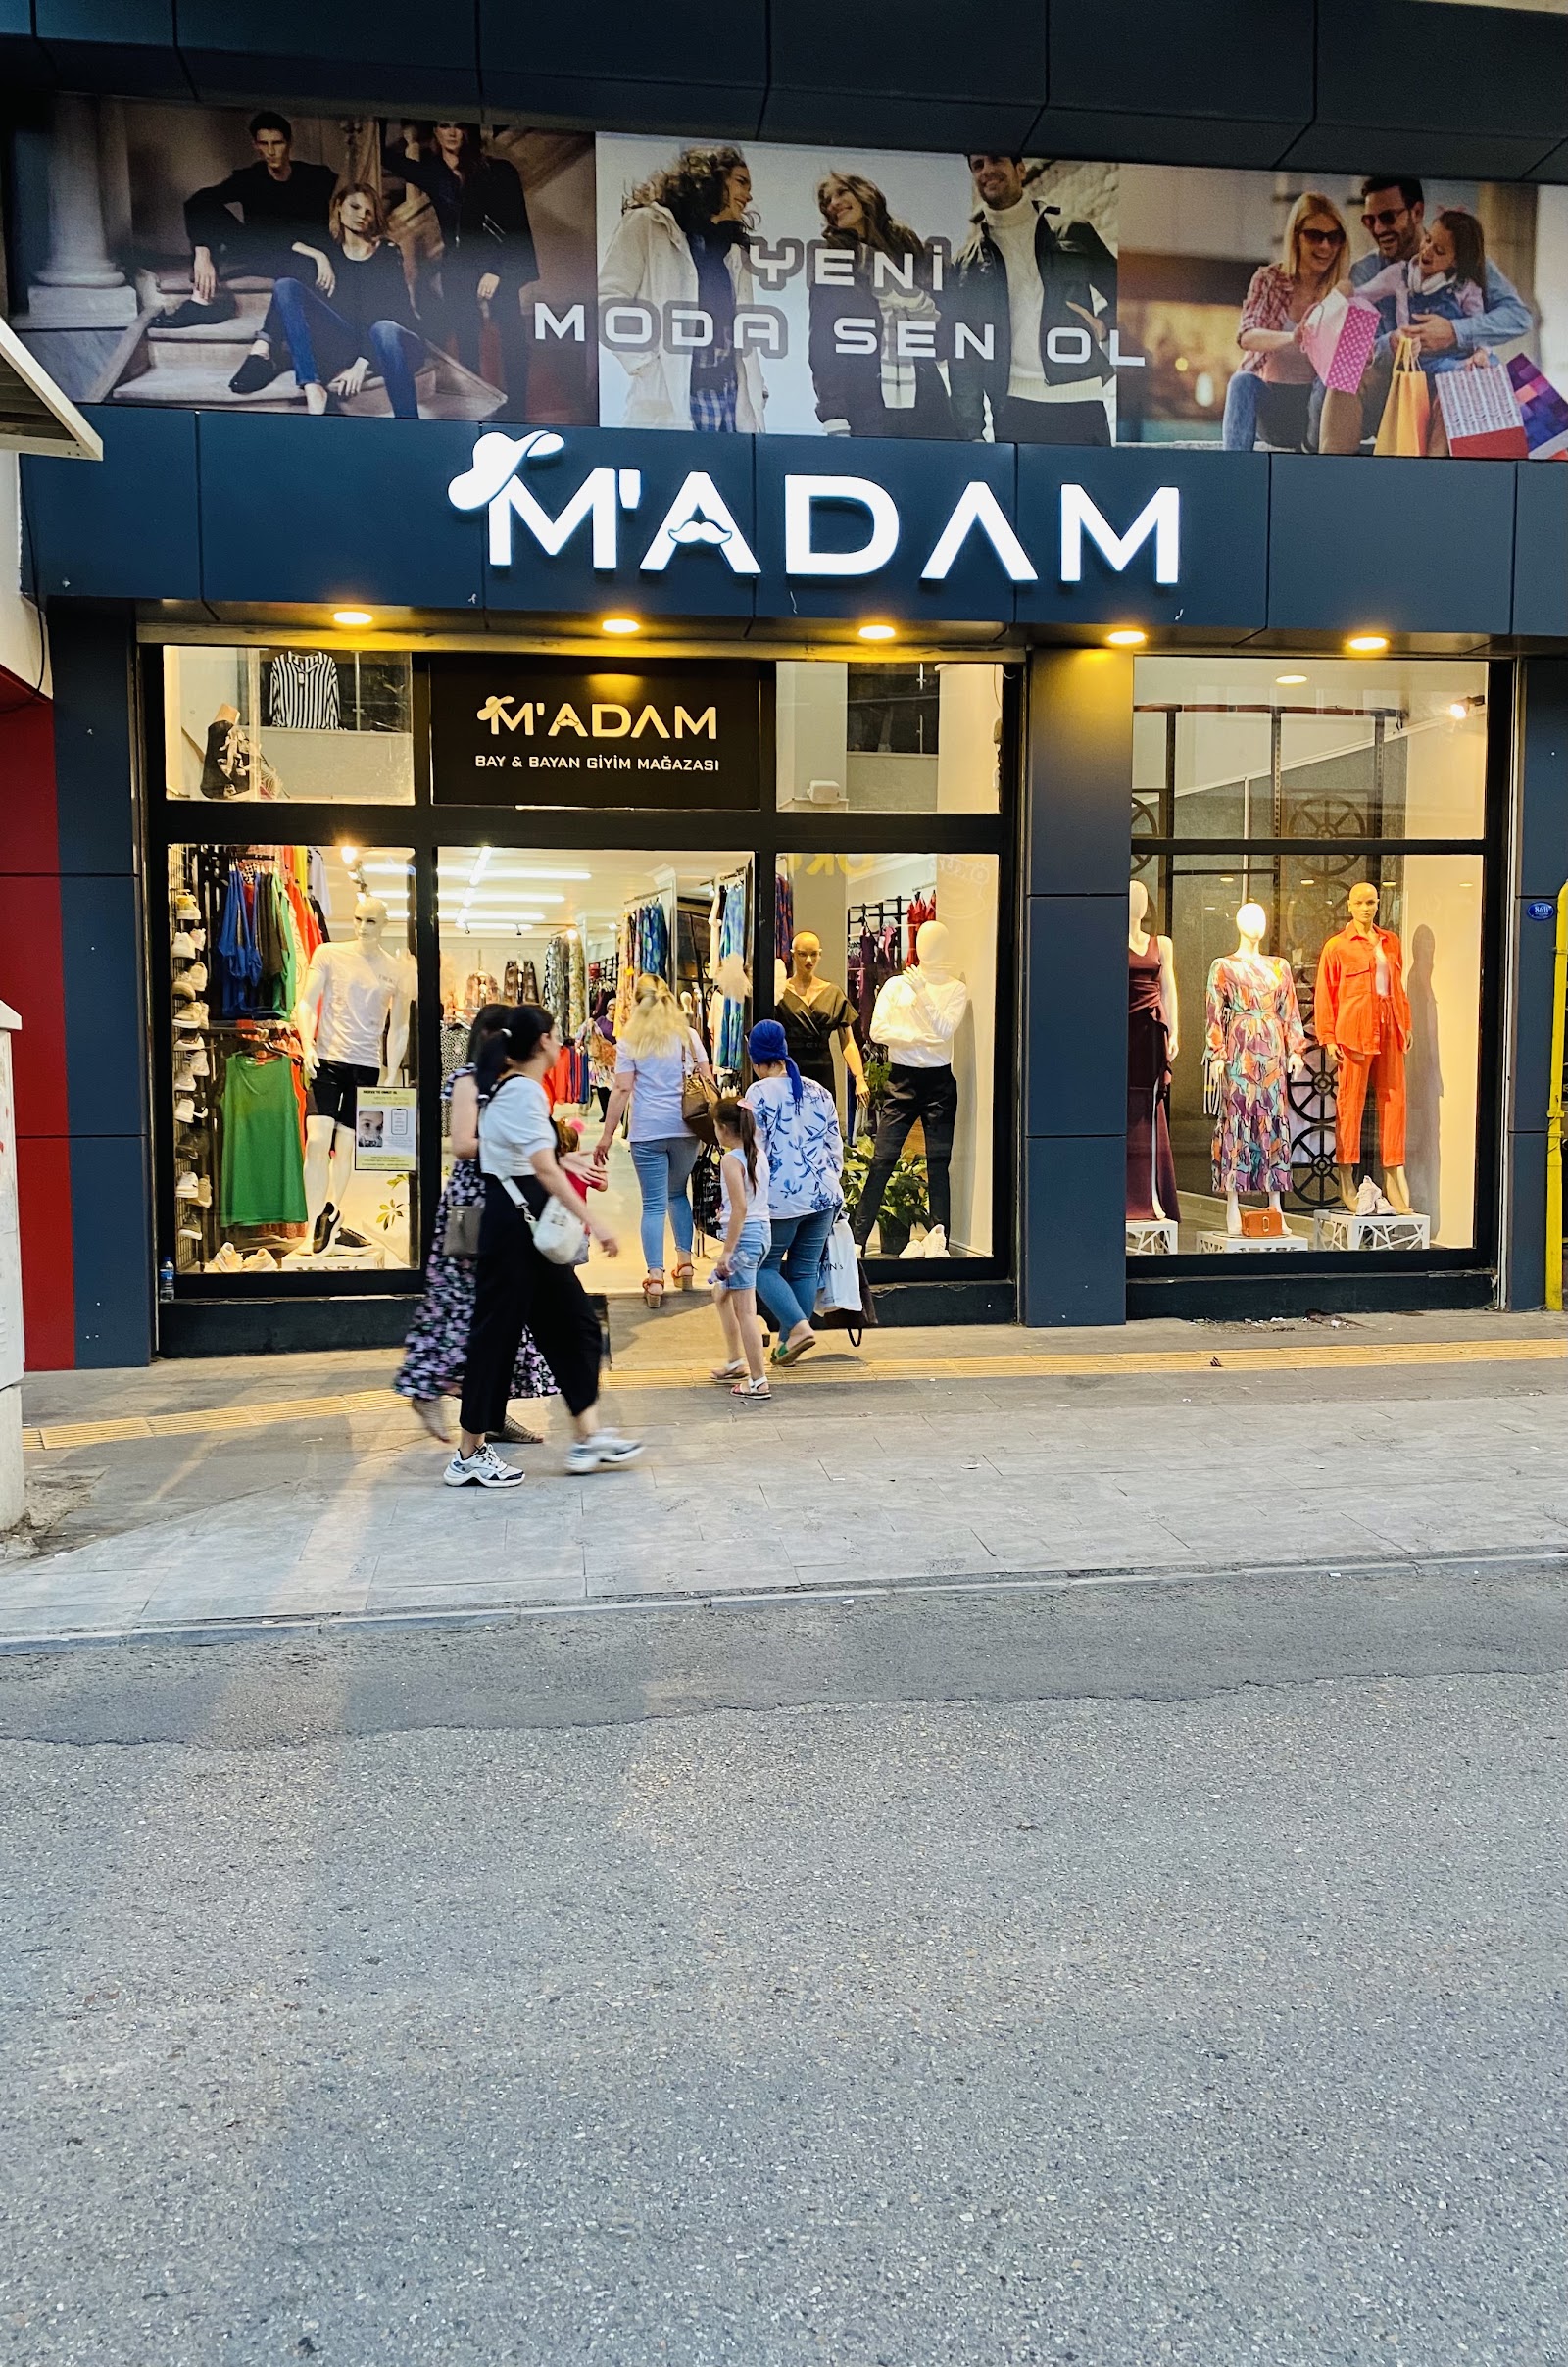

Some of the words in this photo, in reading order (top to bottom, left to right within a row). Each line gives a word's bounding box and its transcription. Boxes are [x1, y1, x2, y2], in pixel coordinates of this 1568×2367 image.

[748, 243, 944, 291] YENİ
[534, 301, 780, 351] MODA
[833, 316, 995, 361] SEN
[1046, 326, 1146, 368] OL
[488, 468, 1180, 585] M'ADAM
[489, 702, 717, 739] M'ADAM
[474, 755, 506, 767] BAY
[512, 756, 523, 767] &
[528, 756, 580, 769] BAYAN
[587, 754, 631, 769] GİYİM
[637, 755, 719, 771] MAĞAZASI
